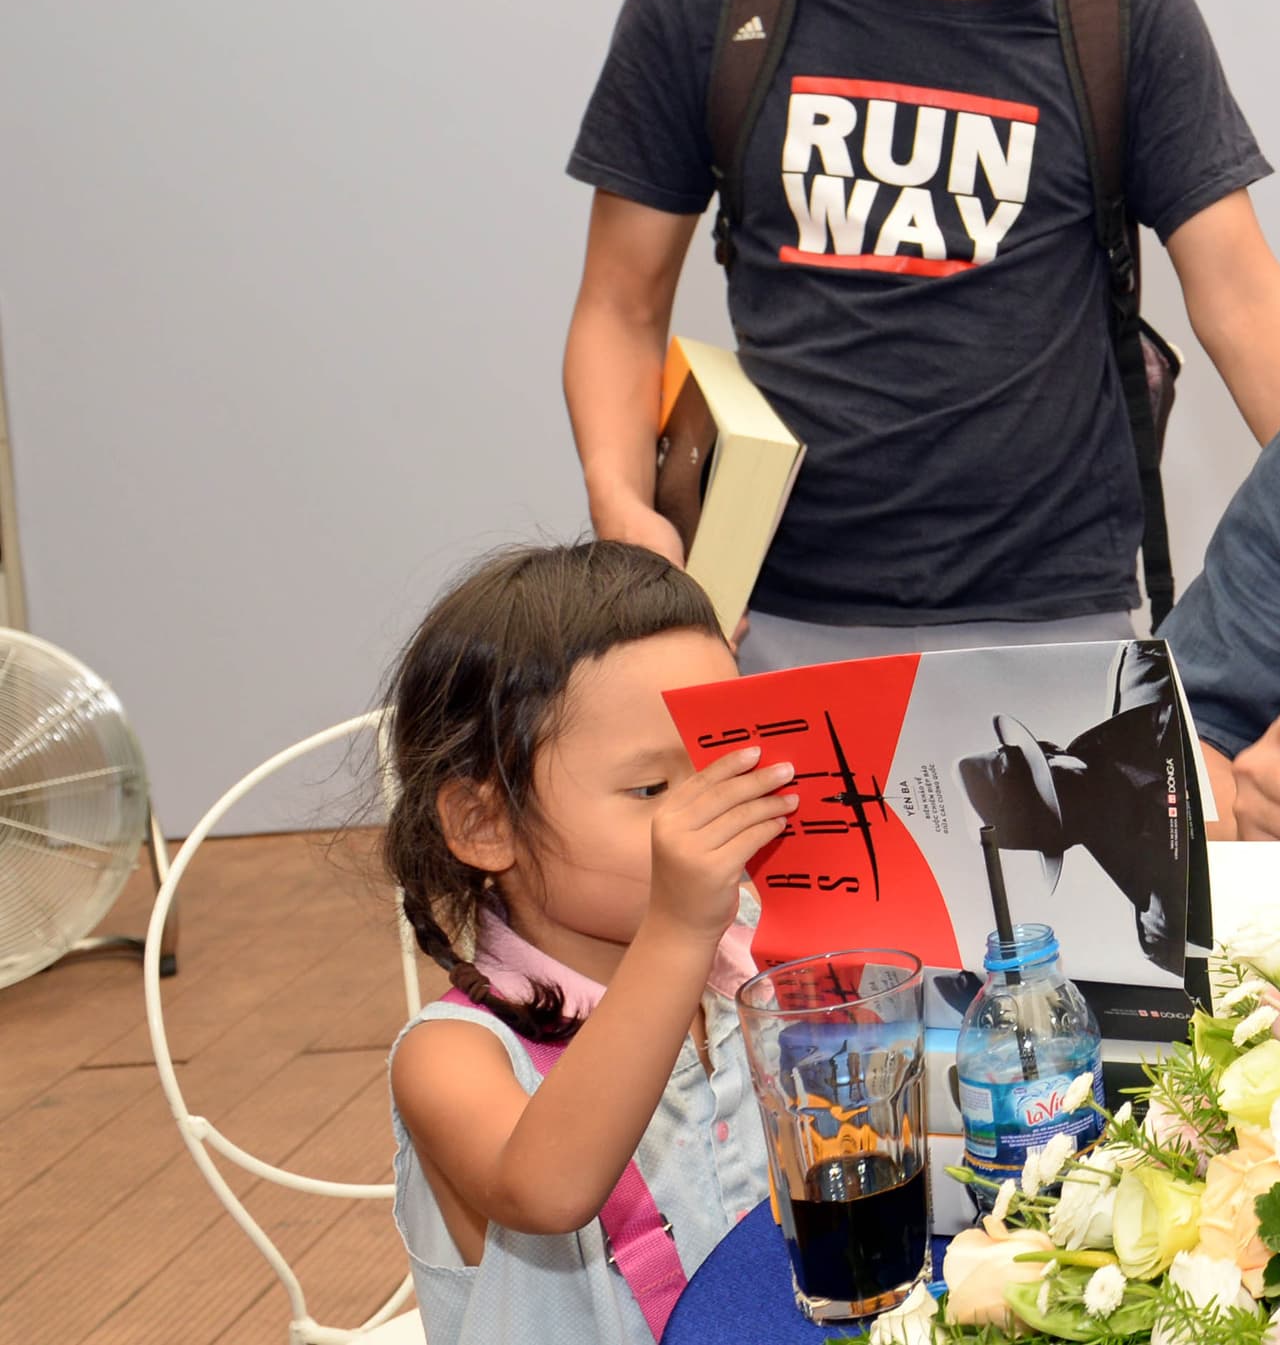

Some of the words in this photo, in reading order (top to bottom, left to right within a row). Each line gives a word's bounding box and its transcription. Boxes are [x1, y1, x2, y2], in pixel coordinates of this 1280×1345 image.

[781, 93, 1037, 203] RUN
[782, 172, 1024, 264] WAY
[899, 780, 910, 794] BA
[903, 797, 916, 817] YÊN
